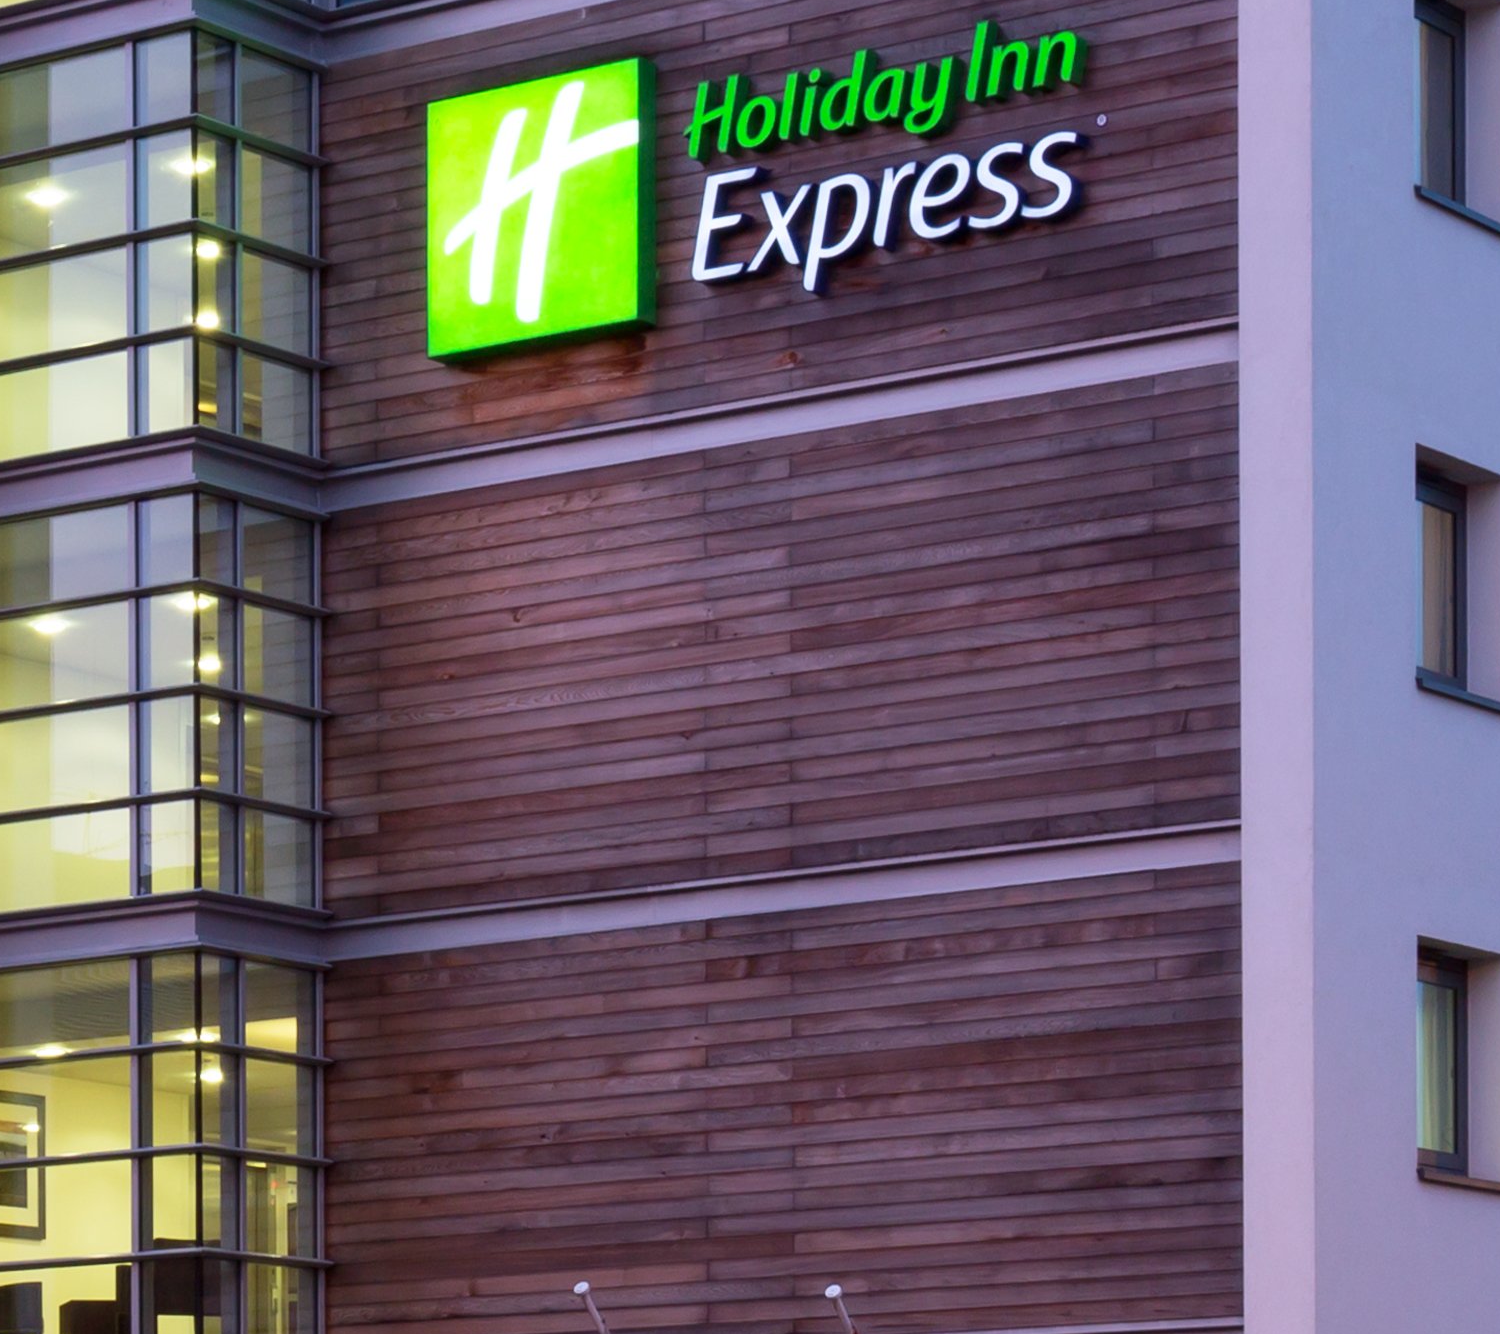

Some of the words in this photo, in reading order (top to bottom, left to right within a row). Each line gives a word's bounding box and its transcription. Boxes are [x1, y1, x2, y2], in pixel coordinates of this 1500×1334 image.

[683, 48, 958, 160] Holiday
[965, 20, 1083, 103] Inn
[691, 131, 1082, 294] Express
